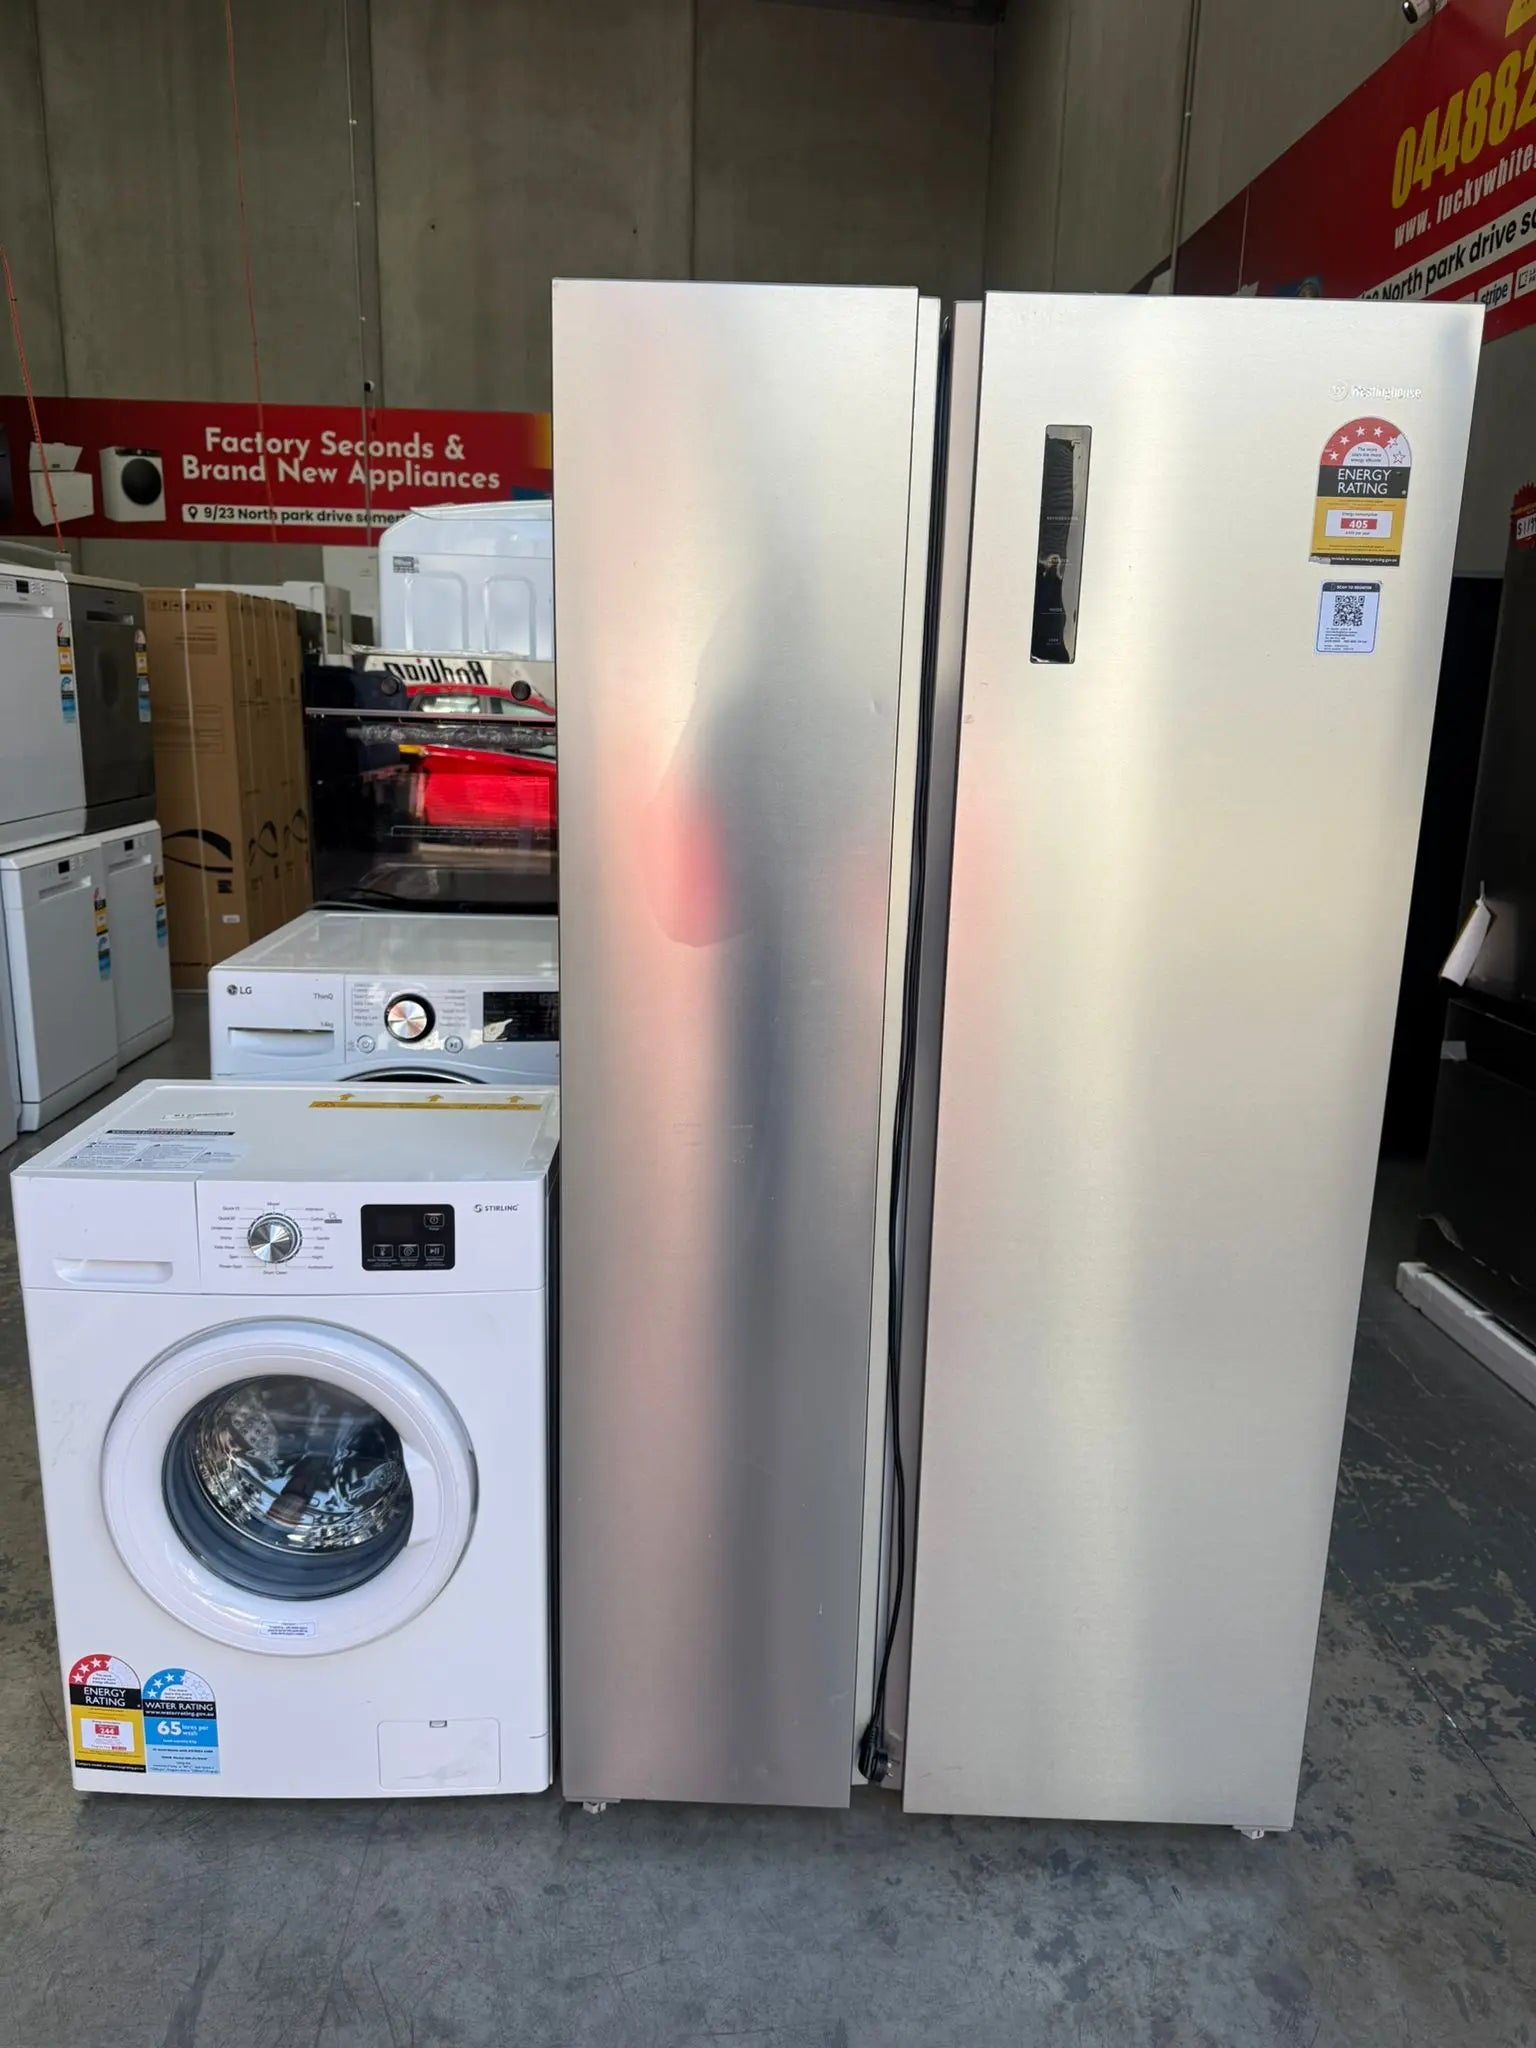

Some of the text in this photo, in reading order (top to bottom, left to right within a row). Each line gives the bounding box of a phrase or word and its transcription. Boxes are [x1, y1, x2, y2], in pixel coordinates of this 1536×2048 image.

[1436, 143, 1536, 224] luckywhite
[1425, 244, 1467, 294] park
[1469, 219, 1517, 264] drive
[1481, 282, 1508, 306] stripe
[205, 427, 466, 461] Factory Seconds &
[182, 454, 500, 492] Brand New Appliances
[1337, 468, 1392, 481] ENERGY
[1337, 482, 1389, 495] RATING
[203, 506, 235, 521] 9/23
[238, 507, 277, 521] North
[281, 509, 314, 524] park
[316, 510, 353, 522] drive
[1348, 520, 1368, 529] 405
[240, 986, 252, 995] LG
[313, 992, 334, 1000] ThinQ
[83, 1686, 126, 1698] ENERGY
[85, 1695, 126, 1707] RATING
[144, 1702, 214, 1711] WATER RATING
[144, 1710, 215, 1718] www.waterrating.gov.au
[157, 1720, 182, 1735] 65
